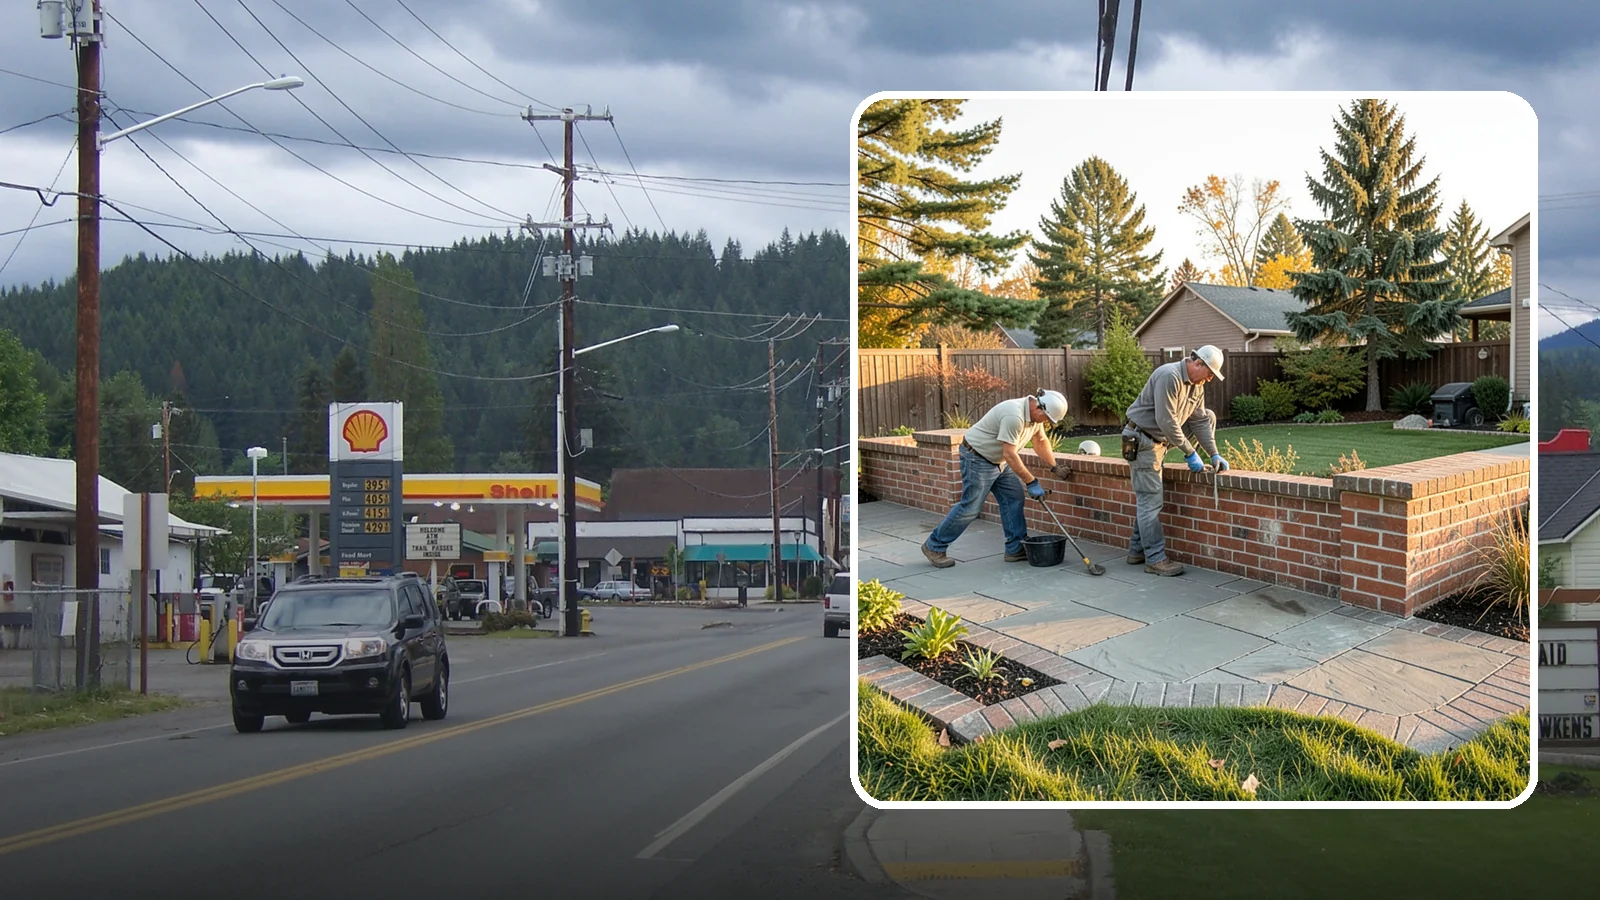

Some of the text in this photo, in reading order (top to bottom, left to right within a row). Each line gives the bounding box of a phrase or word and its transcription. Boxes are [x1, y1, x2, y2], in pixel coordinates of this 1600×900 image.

[366, 480, 383, 490] 395
[490, 484, 547, 498] Shell
[366, 494, 383, 504] 405
[366, 508, 383, 518] 415
[366, 522, 383, 532] 429
